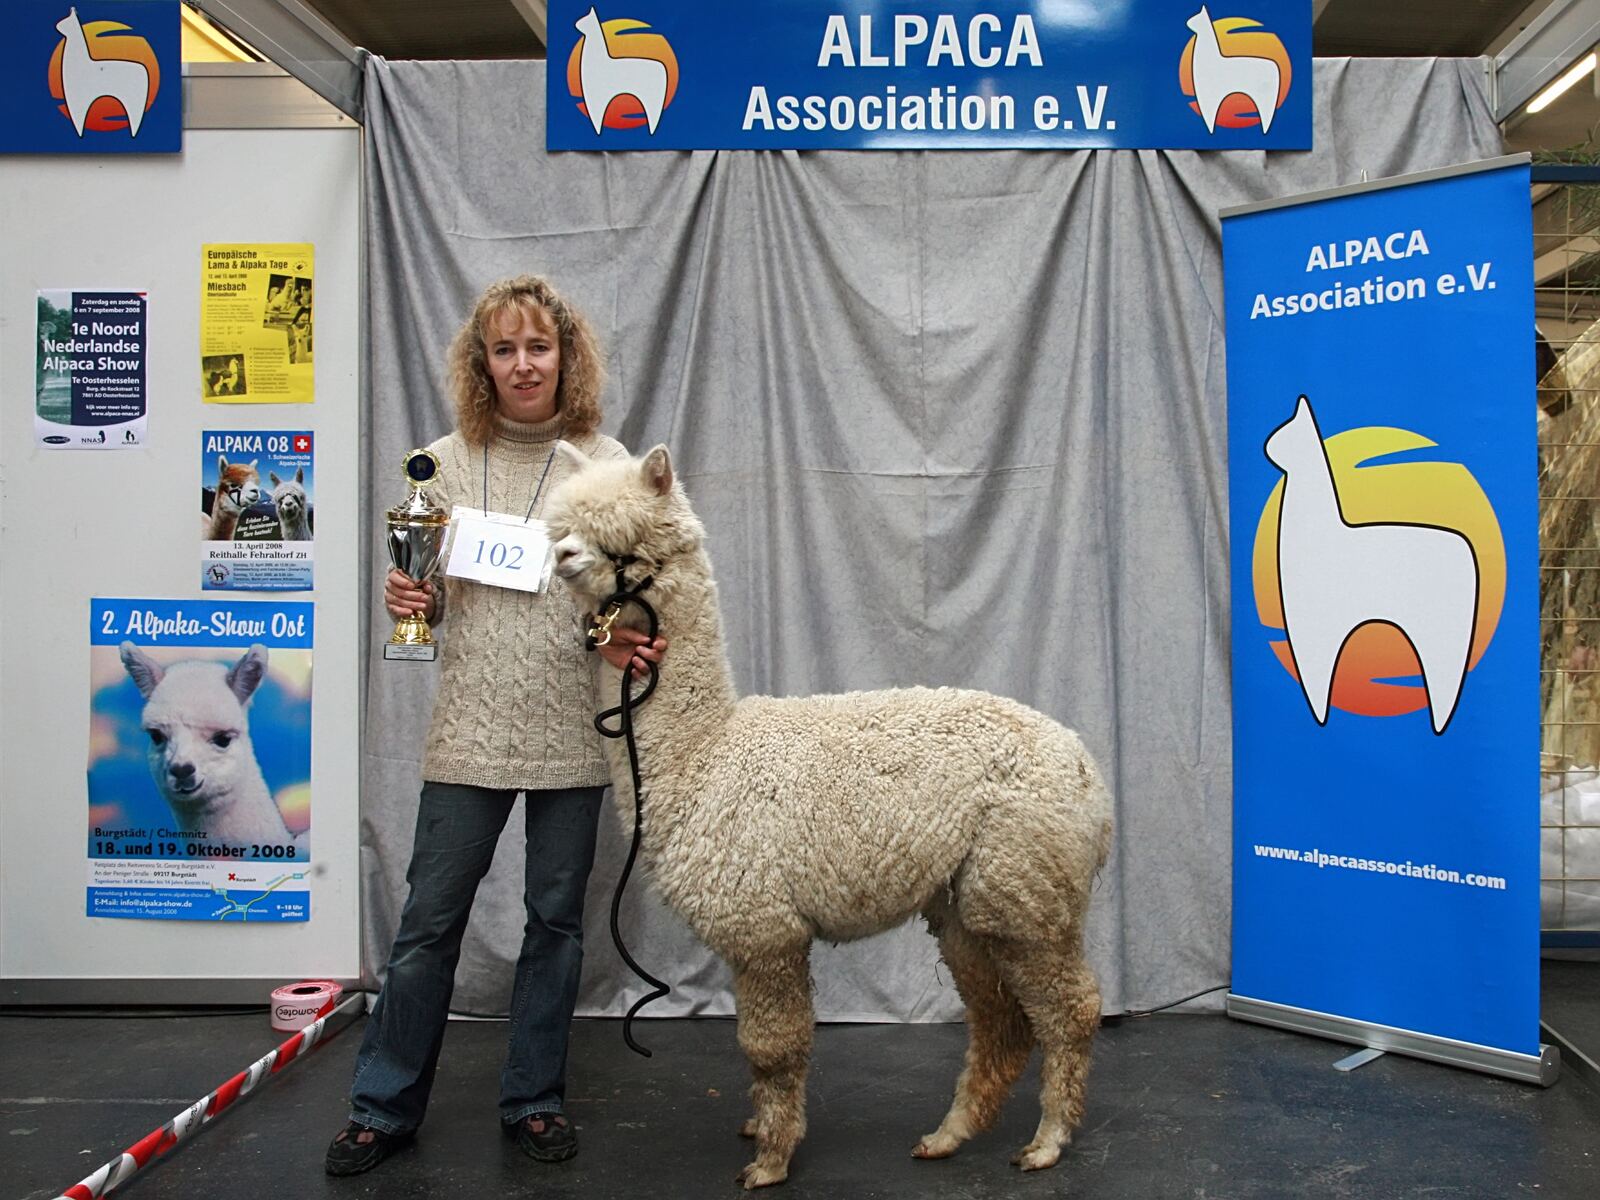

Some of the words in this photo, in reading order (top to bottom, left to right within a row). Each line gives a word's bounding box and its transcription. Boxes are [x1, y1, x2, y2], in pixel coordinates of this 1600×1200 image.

[817, 13, 1044, 67] ALPACA
[742, 85, 1014, 131] Association
[1033, 85, 1116, 131] e.V.
[207, 250, 258, 260] Europäische
[1305, 229, 1430, 273] ALPACA
[208, 261, 230, 269] Lama
[232, 261, 238, 269] &
[240, 261, 267, 270] Alpaka
[270, 260, 288, 270] Tage
[207, 282, 247, 291] Miesbach
[1250, 276, 1426, 320] Association
[1436, 262, 1496, 295] e.V.
[72, 322, 88, 335] 1e
[92, 322, 139, 335] Noord
[44, 339, 140, 353] Nederlandse
[43, 357, 94, 374] Alpaca
[98, 357, 139, 370] Show
[206, 436, 263, 453] ALPAKA
[267, 436, 289, 453] 08
[210, 551, 248, 559] Reithalle
[250, 551, 294, 559] Fehraltorf
[473, 539, 524, 570] 102
[102, 610, 118, 634] 2.
[125, 610, 266, 641] Alpaka-Show
[271, 612, 306, 638] Ost
[95, 828, 146, 839] Burgstädt
[149, 828, 153, 840] /
[157, 828, 208, 839] Chemnitz
[96, 842, 121, 855] 18.
[125, 843, 152, 855] und
[158, 843, 182, 855] 19.
[186, 843, 246, 857] Oktober
[251, 844, 296, 858] 2008
[1254, 844, 1506, 890] www.alpacaassociation.com
[120, 899, 192, 908] info@alpaka-show.de
